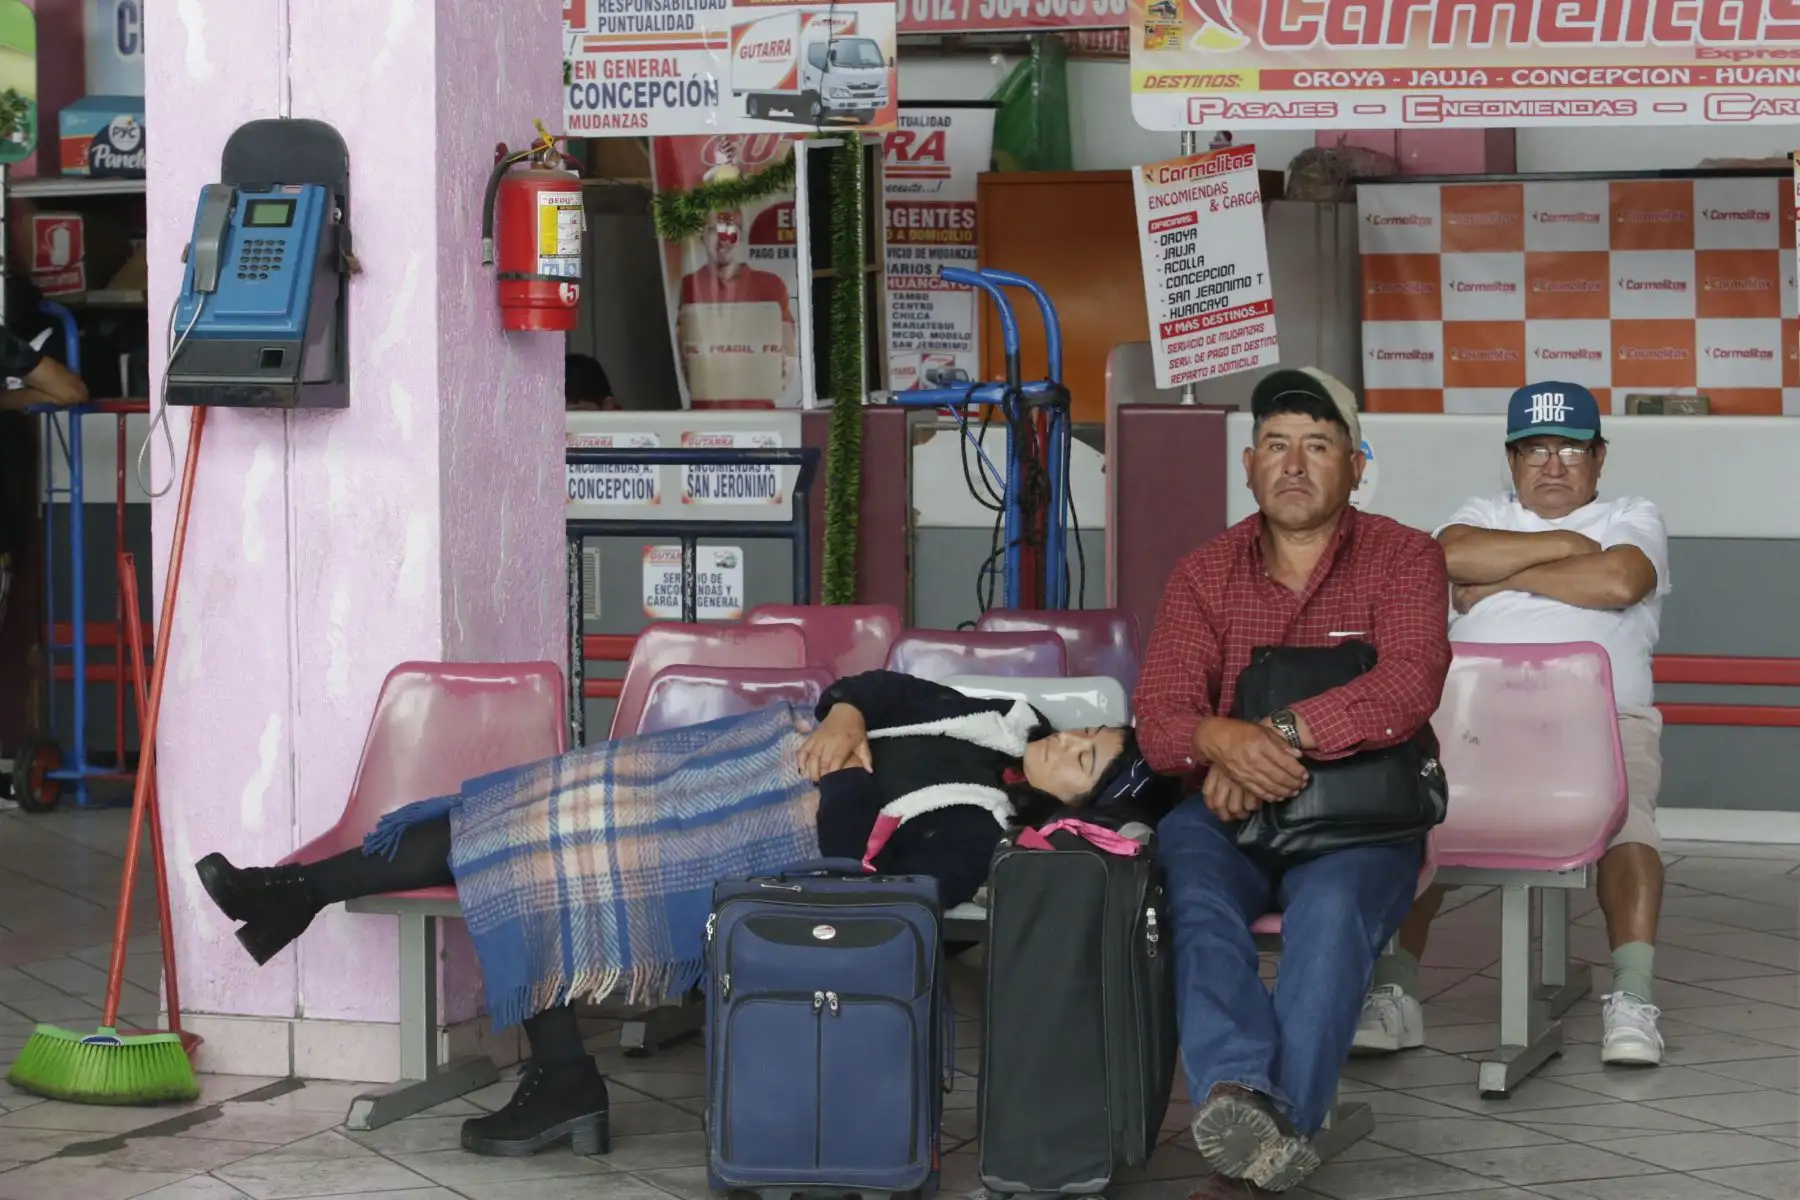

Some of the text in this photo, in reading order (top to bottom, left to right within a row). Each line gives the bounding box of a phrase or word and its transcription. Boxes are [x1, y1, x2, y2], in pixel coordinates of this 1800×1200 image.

[598, 13, 694, 33] PUNTUALIDAD
[740, 39, 792, 59] GUTARRA
[575, 57, 682, 80] EN GENERAL
[1293, 71, 1385, 87] OROYA
[1408, 69, 1488, 86] JAUJA
[1511, 68, 1691, 85] CONCEPCION
[1715, 67, 1800, 84] HUAN
[569, 73, 719, 110] CONCEPCIÓN
[1704, 92, 1800, 122] CAR
[568, 113, 649, 130] MUDANZAS
[1159, 153, 1254, 184] Carmelitas
[1148, 181, 1229, 210] ENCOMIENDAS
[1222, 190, 1262, 209] CARGA
[1163, 242, 1197, 261] JAUJA
[1164, 255, 1205, 275] ACOLLA
[1166, 264, 1235, 290] CONCEPCION
[1168, 289, 1191, 306] SAN
[1195, 275, 1252, 299] JERONIMO
[892, 302, 933, 310] CENTRO
[892, 312, 930, 320] CHILCA
[1170, 295, 1229, 320] HUANCAYO
[1175, 319, 1200, 333] MAS
[568, 478, 654, 499] CONCEPCION
[687, 474, 776, 498] SAN JERONIMO
[711, 573, 723, 584] DE
[647, 595, 740, 608] CARGA GENERAL
